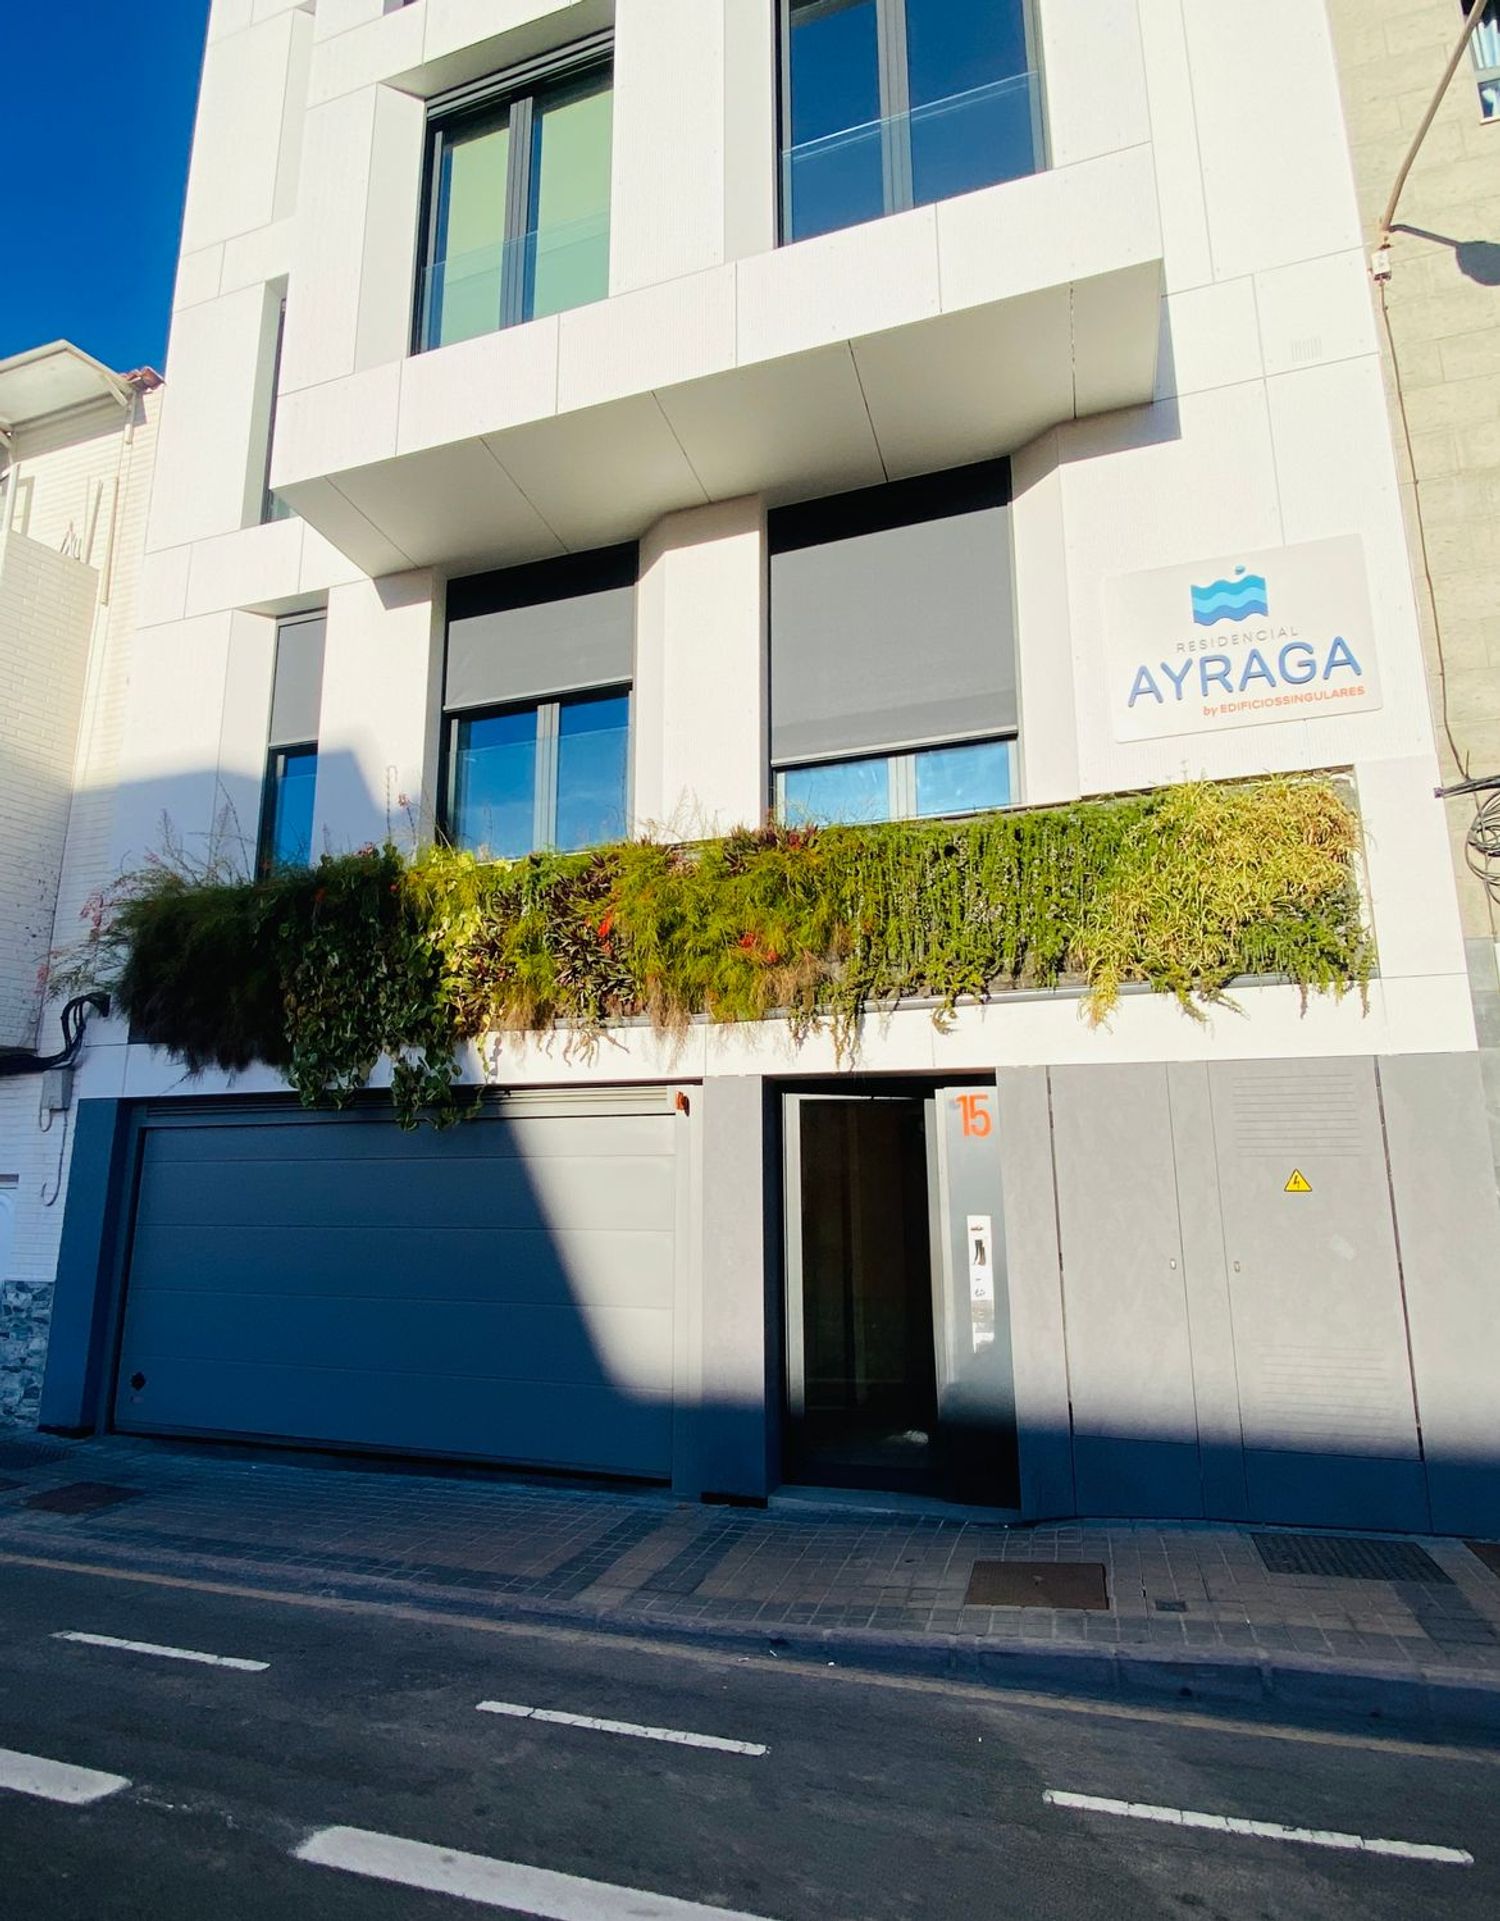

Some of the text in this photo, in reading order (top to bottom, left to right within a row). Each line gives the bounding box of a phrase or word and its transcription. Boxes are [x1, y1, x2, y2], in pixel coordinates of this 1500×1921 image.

[1177, 627, 1299, 653] RESIDENCIAL
[1128, 636, 1362, 708] AYRAGA
[1203, 686, 1365, 717] by EDIFICIOSSINGULARES
[956, 1094, 992, 1136] 15
